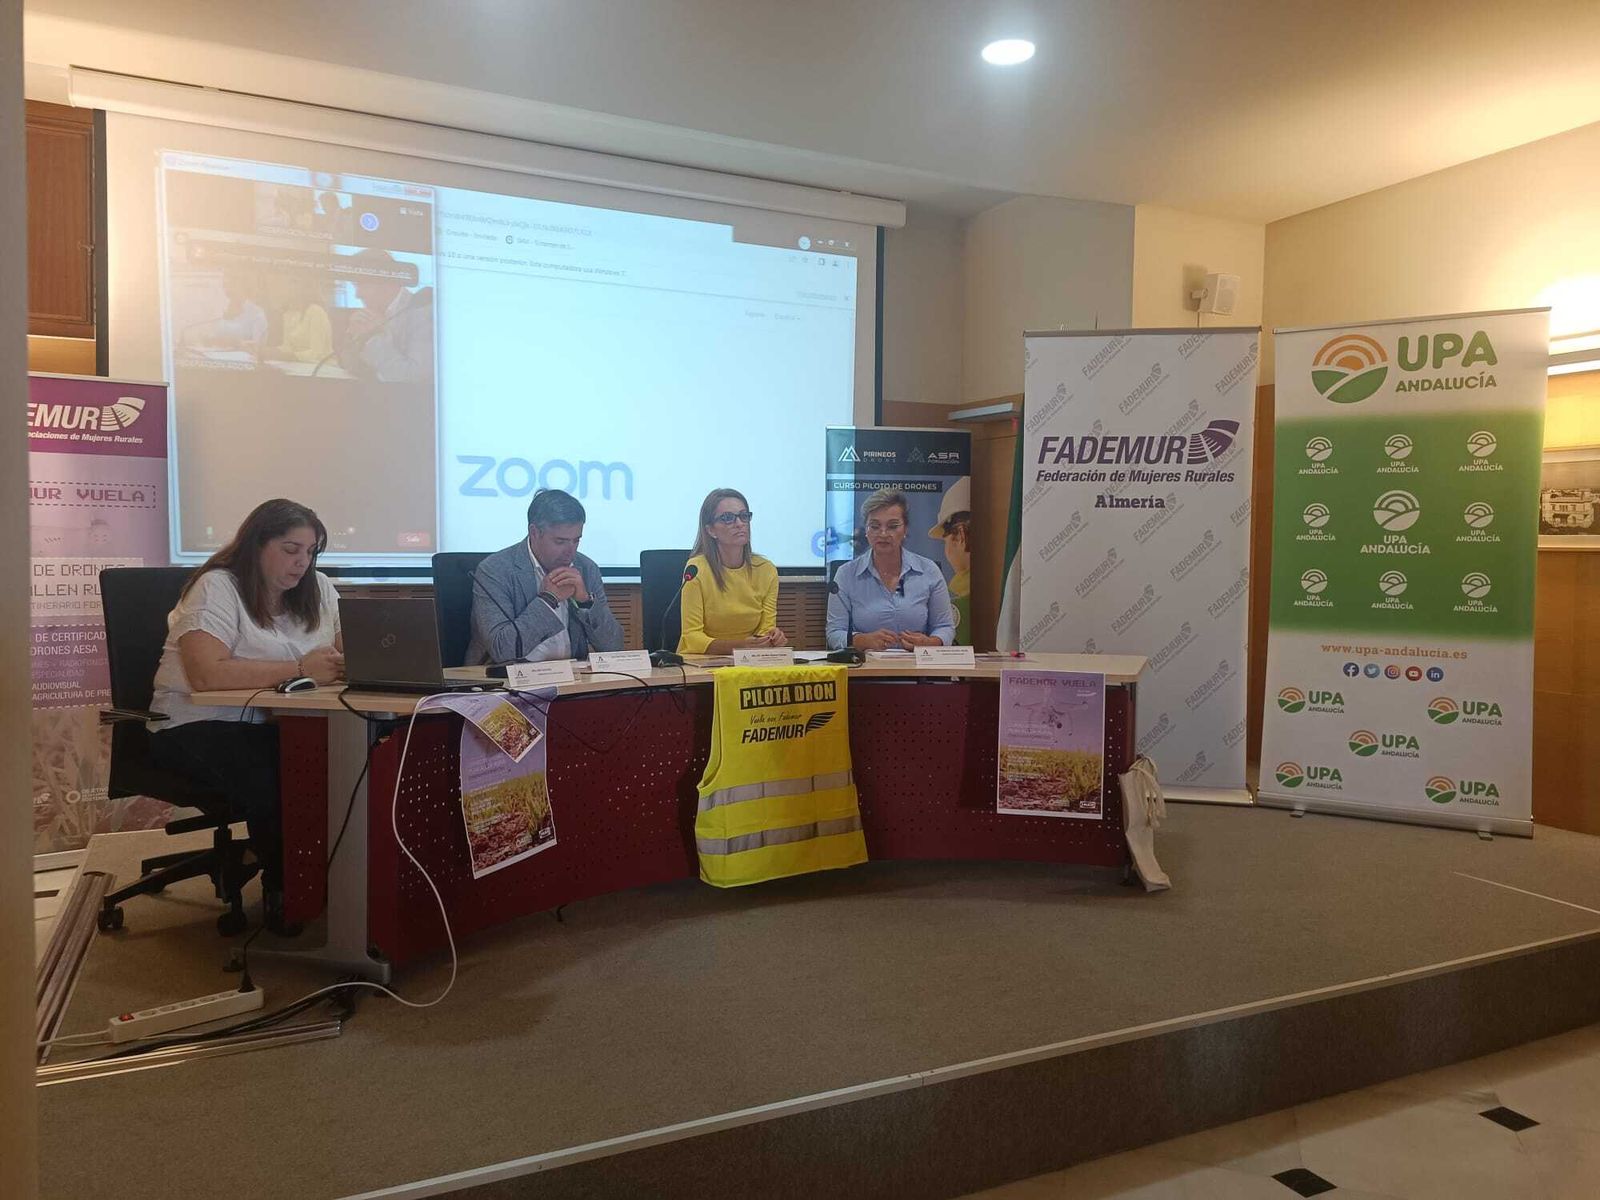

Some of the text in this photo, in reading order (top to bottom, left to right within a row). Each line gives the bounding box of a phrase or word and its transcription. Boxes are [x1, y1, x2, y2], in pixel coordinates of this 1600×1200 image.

[1397, 330, 1498, 372] UPA
[1395, 372, 1497, 392] ANDALUCÍA
[82, 433, 113, 443] Mujeres
[114, 435, 144, 444] Rurales
[1037, 436, 1187, 465] FADEMUR
[1299, 467, 1339, 475] ANDALUCÍA
[1377, 466, 1419, 474] ANDALUCÍA
[1459, 463, 1503, 472] ANDALUCÍA
[456, 456, 633, 501] zoom
[1036, 469, 1235, 485] Federación de Mujeres Rurales
[833, 482, 860, 490] CURSO
[862, 482, 892, 490] PILOTO
[904, 483, 938, 491] DRONES
[77, 488, 145, 502] VUELA
[1095, 495, 1166, 509] Almería
[1296, 534, 1336, 542] ANDALUCÍA
[1383, 535, 1407, 545] UPA
[1456, 534, 1500, 543] ANDALUCÍA
[1360, 542, 1431, 555] ANDALUCÍA
[33, 564, 126, 577] DE DRON
[1294, 599, 1334, 608] ANDALUCÍA
[1371, 601, 1414, 610] ANDALUCÍA
[1453, 604, 1498, 613] ANDALUCÍA
[35, 632, 49, 643] DE
[72, 644, 99, 655] AESA
[32, 681, 81, 691] AUDIOVISUAL
[32, 690, 83, 701] AGRICULTURA
[85, 690, 96, 698] DE
[743, 683, 835, 707] PILOTA DRON
[1308, 690, 1345, 706] UPA
[1308, 706, 1345, 715] ANDALUCÍA
[1463, 701, 1503, 718] UPA
[1462, 717, 1502, 726] ANDALUCÍA
[741, 724, 804, 745] FADEMUR
[1381, 734, 1420, 751] UPA
[1381, 750, 1420, 759] ANDALUCÍA
[1306, 766, 1343, 783] UPA
[1306, 781, 1343, 791] ANDALUCÍA
[1459, 780, 1500, 798] UPA
[1459, 797, 1500, 807] ANDALUCÍA
